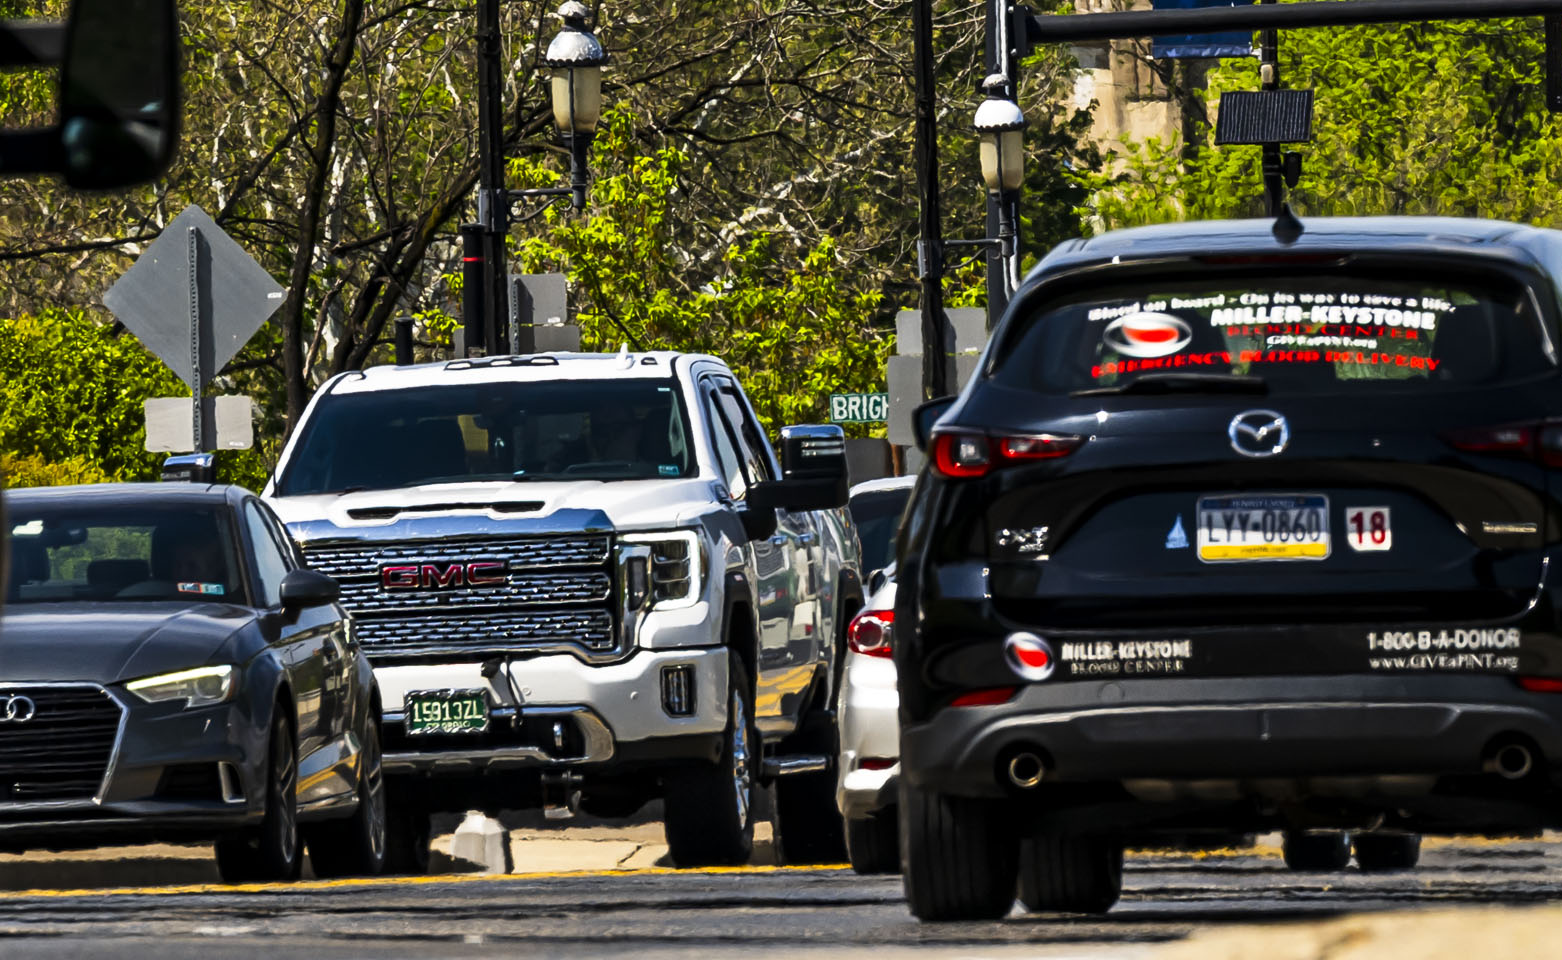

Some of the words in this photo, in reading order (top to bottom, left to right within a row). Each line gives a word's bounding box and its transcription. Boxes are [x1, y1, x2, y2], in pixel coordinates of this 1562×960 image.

[1210, 305, 1436, 330] MILLER-KEYSTONE
[1320, 325, 1418, 340] CENTER
[1239, 350, 1320, 363] BLOOD
[1325, 351, 1440, 371] DELIVERY
[1351, 511, 1386, 545] 18
[382, 562, 505, 589] GMC
[1061, 640, 1193, 661] MILLER-KEYSTONE
[1124, 660, 1185, 673] CENTER
